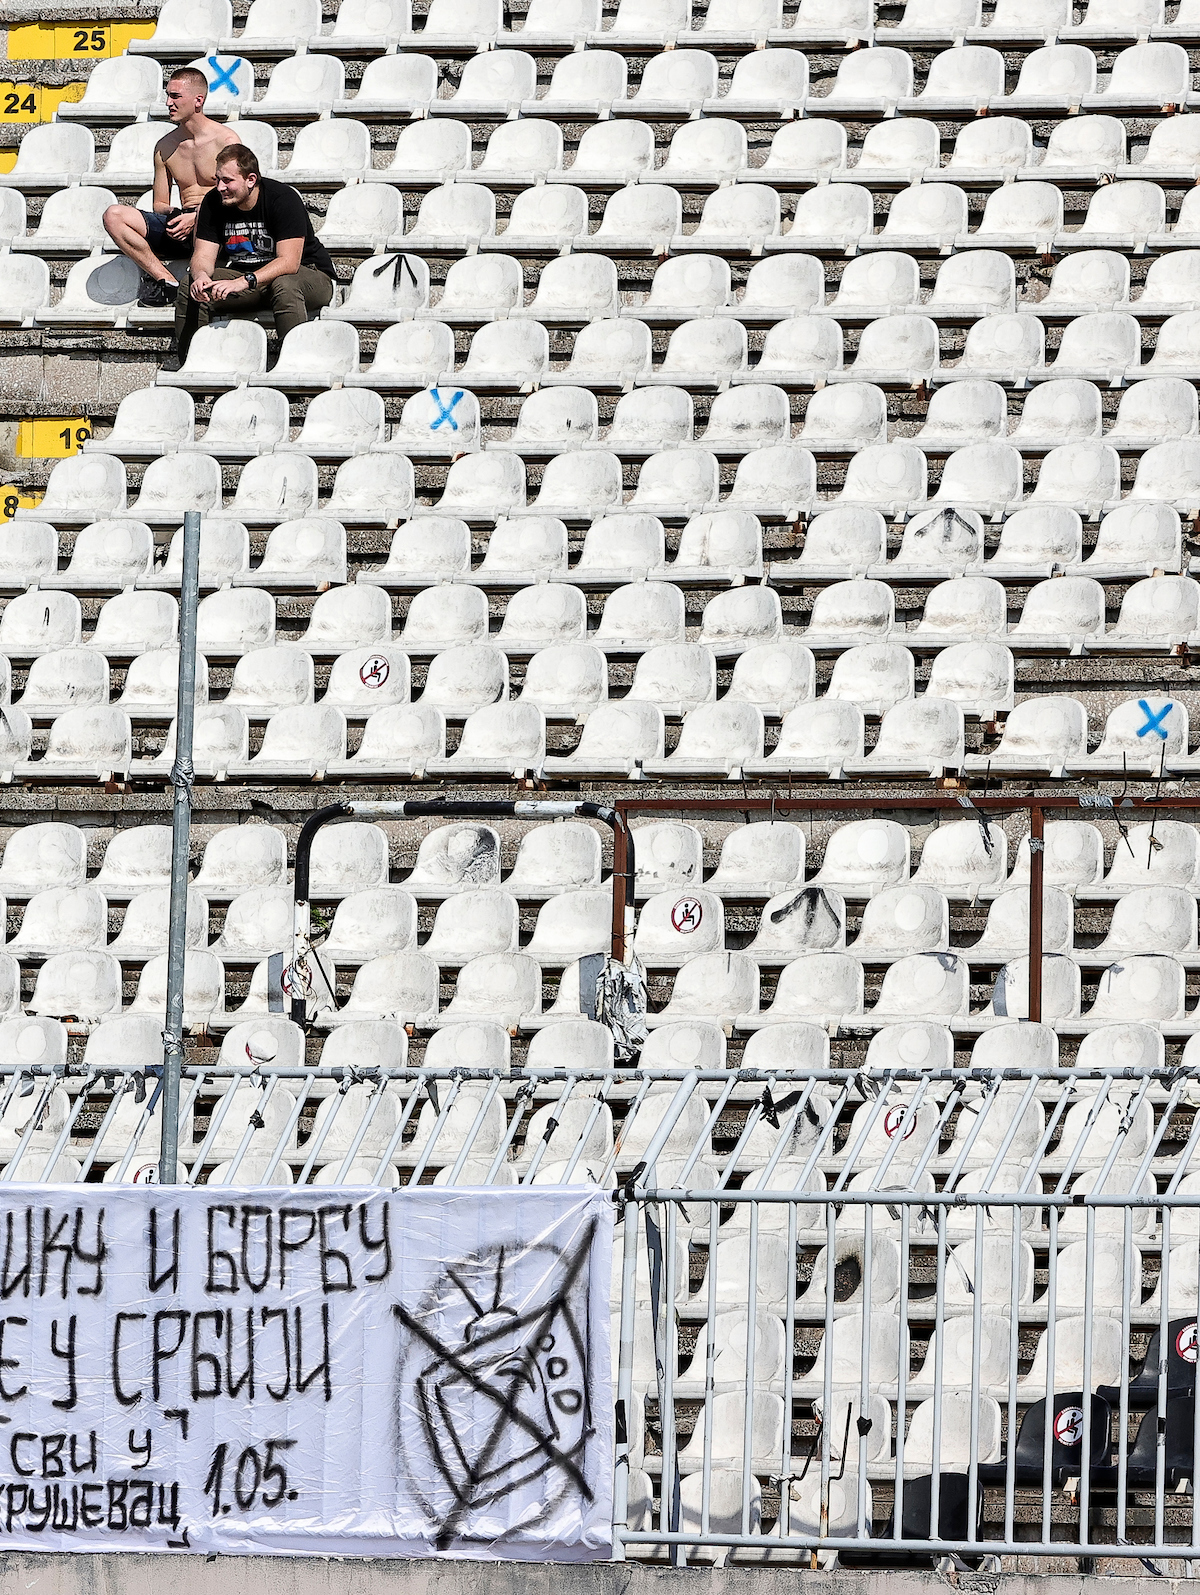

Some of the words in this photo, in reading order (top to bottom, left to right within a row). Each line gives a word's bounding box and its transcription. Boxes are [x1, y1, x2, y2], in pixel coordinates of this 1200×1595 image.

[73, 30, 106, 51] 25
[4, 93, 37, 114] 24
[60, 427, 91, 449] 19
[147, 1206, 181, 1293] И
[205, 1200, 393, 1294] БОРБУ
[49, 1314, 78, 1410] У
[112, 1304, 333, 1406] СРБИЈИ
